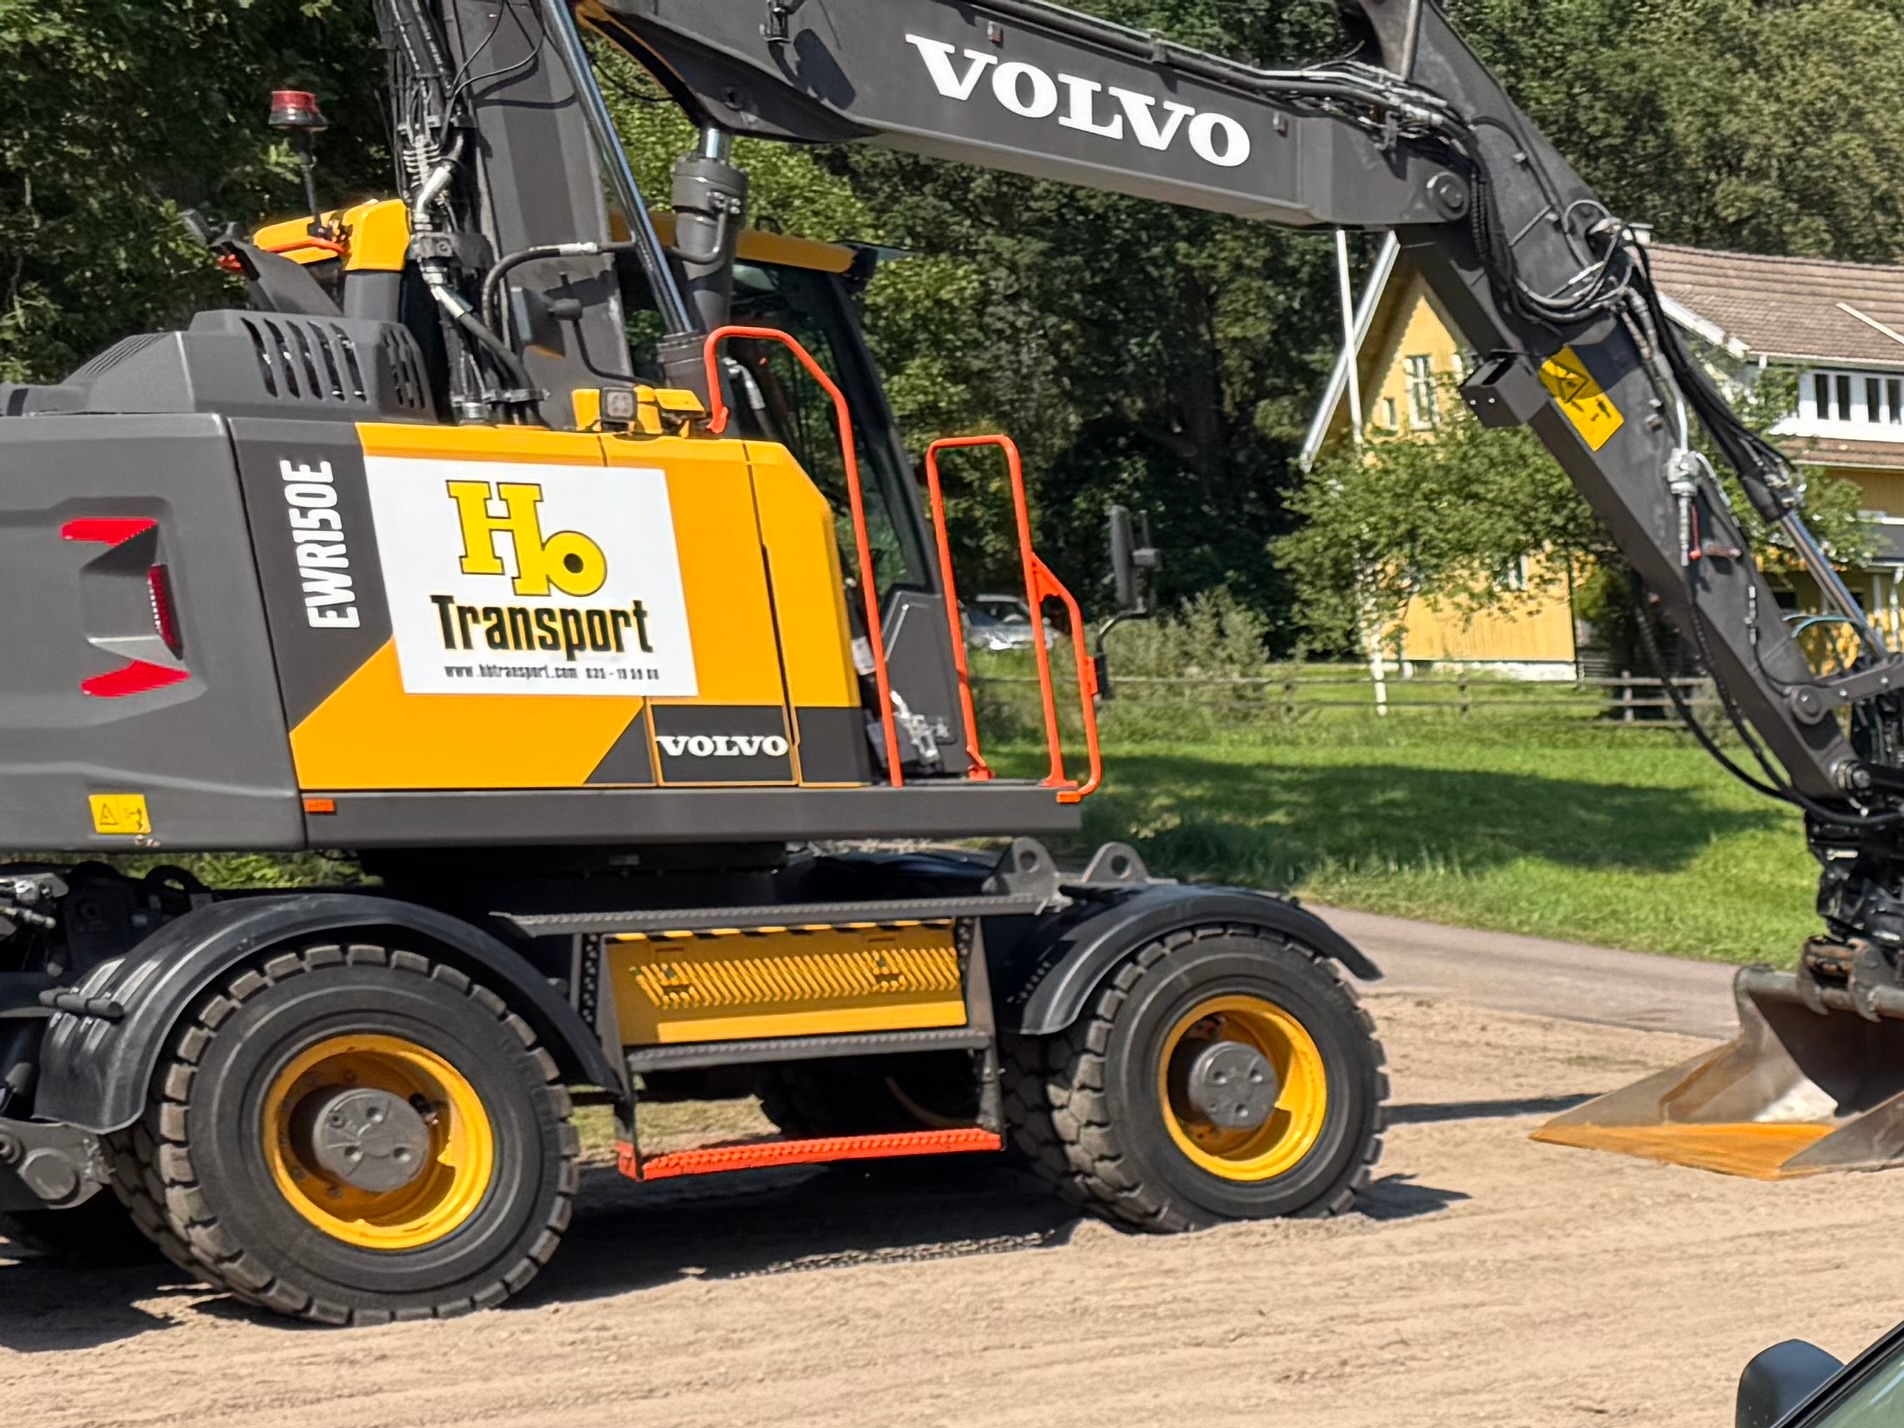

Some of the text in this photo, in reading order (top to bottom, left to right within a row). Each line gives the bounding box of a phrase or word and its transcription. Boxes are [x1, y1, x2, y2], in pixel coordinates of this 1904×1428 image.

[905, 33, 1250, 167] VOLVO
[280, 460, 360, 628] EWR150E
[429, 595, 653, 661] Transport
[655, 735, 789, 757] VOLVO
